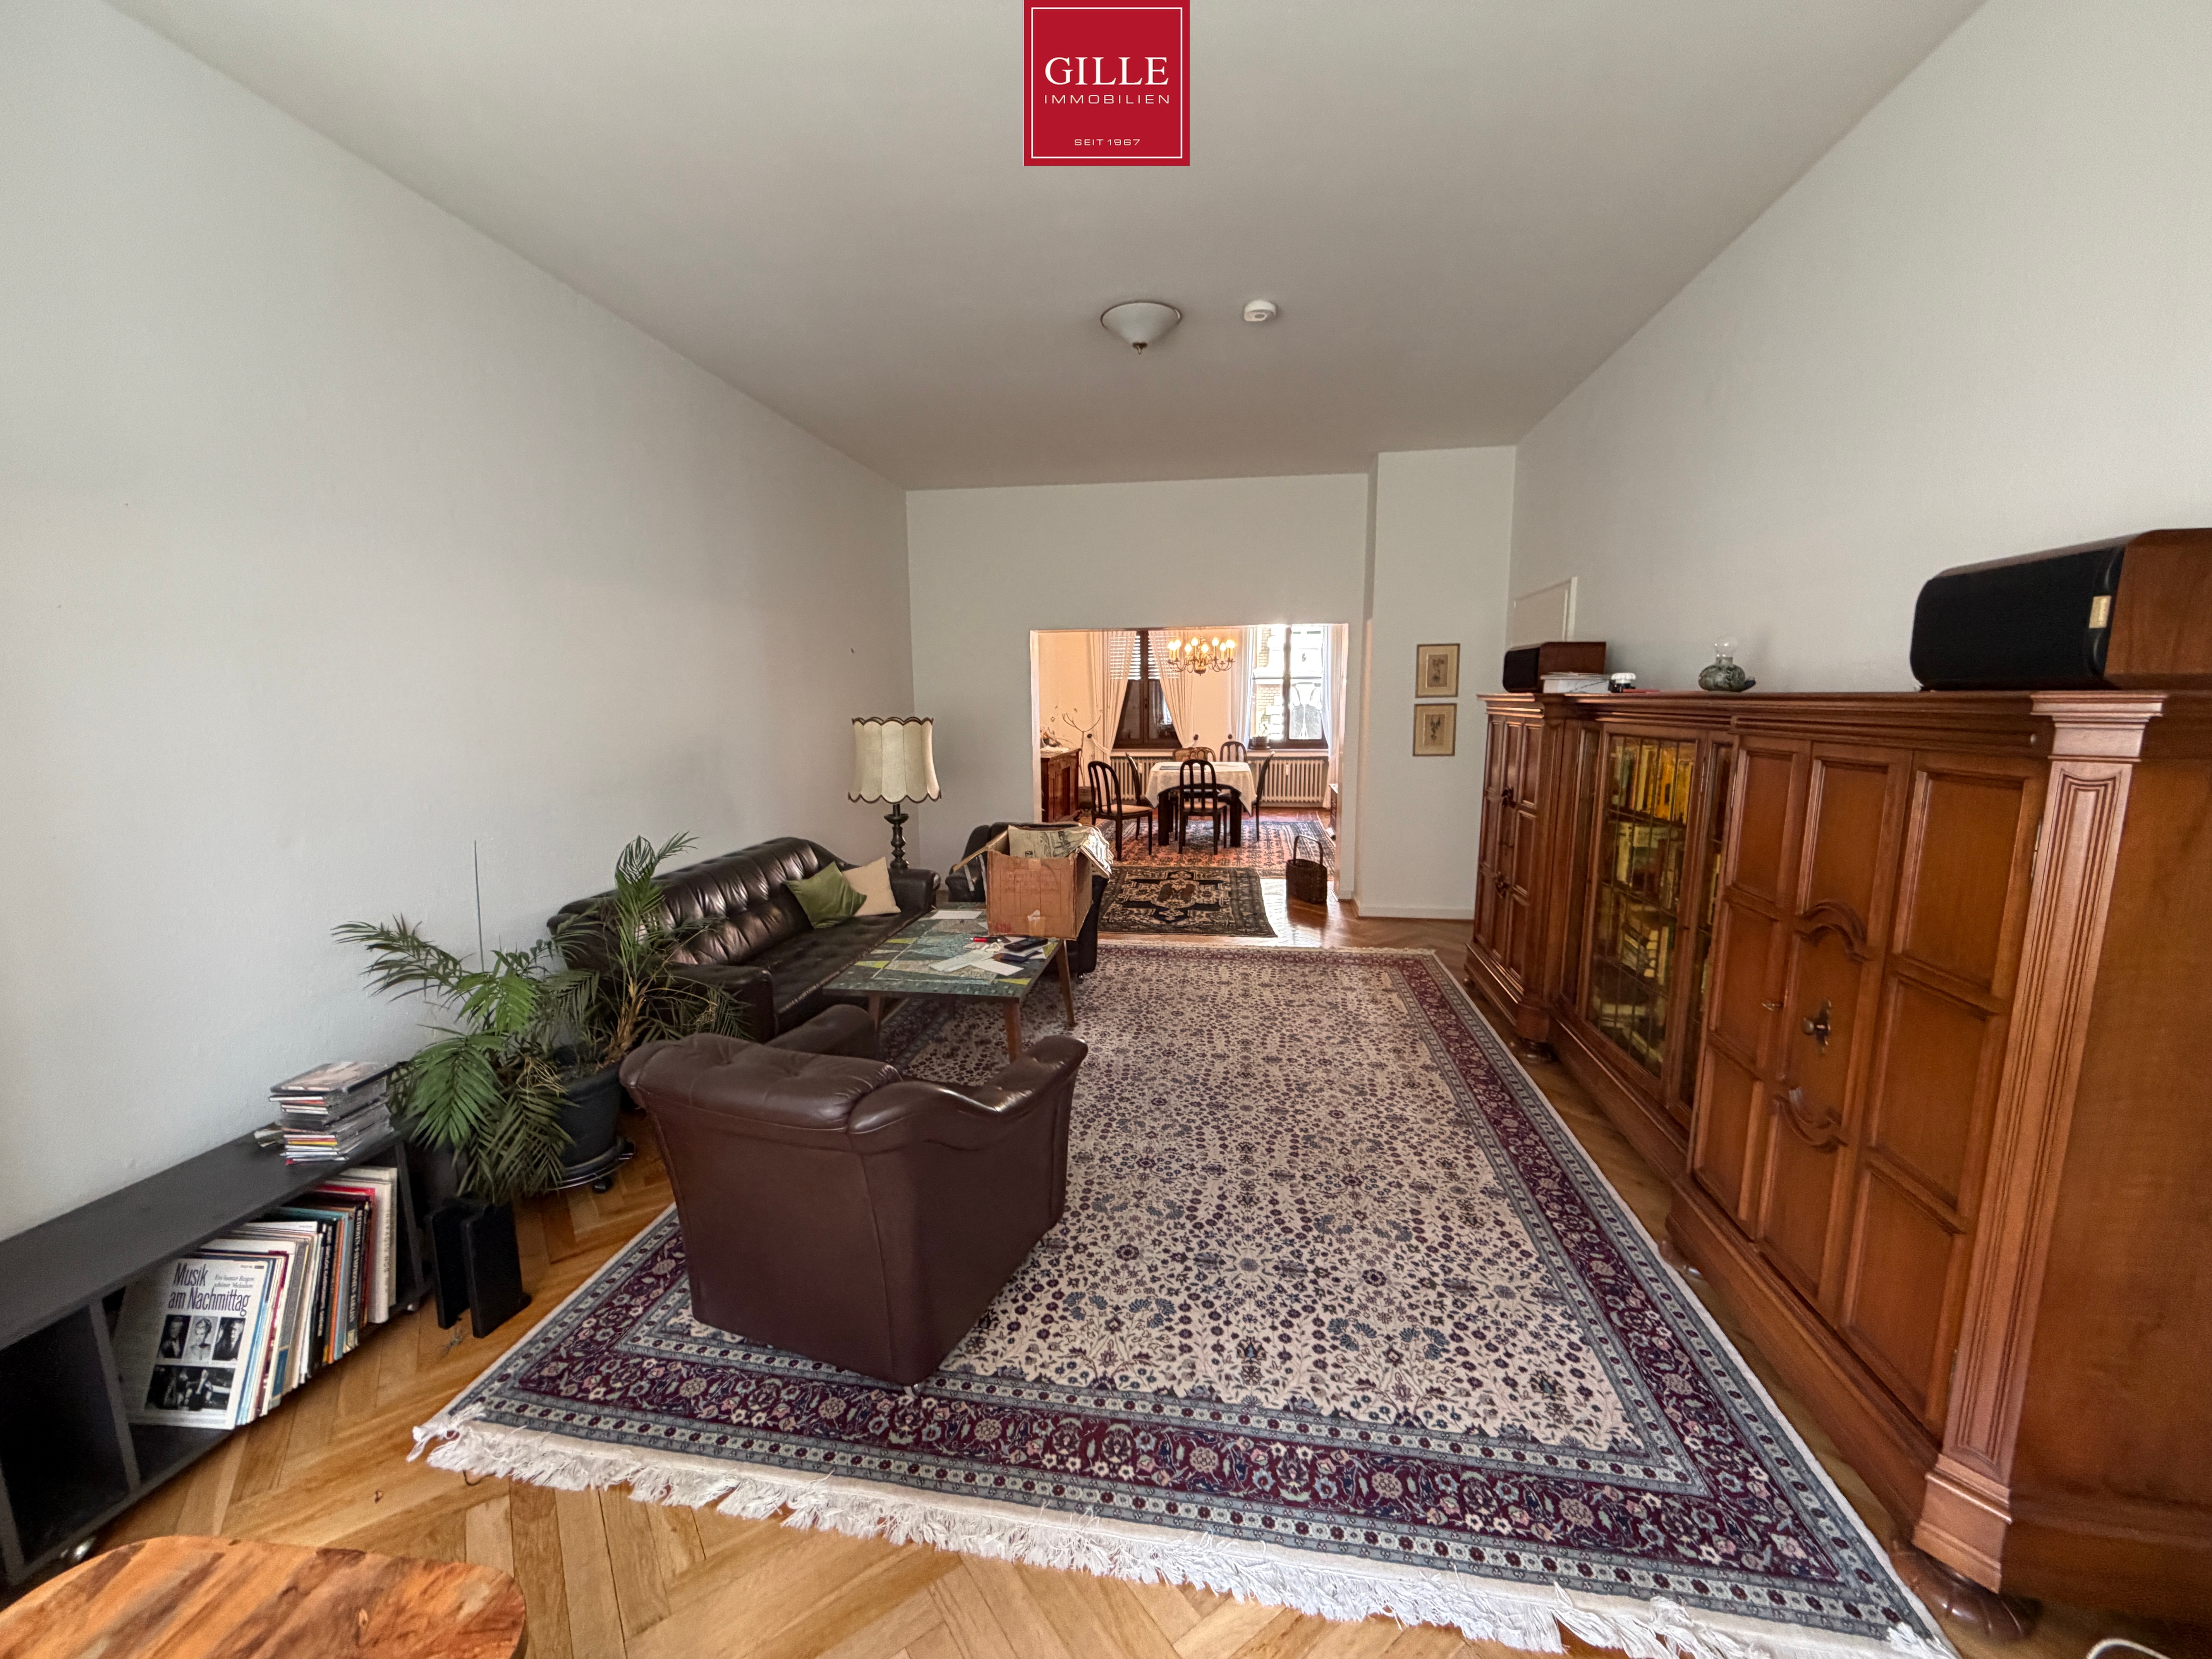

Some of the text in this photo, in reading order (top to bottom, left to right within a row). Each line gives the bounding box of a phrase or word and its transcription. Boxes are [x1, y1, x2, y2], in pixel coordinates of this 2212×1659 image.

[173, 1263, 209, 1286] Musik
[168, 1285, 251, 1317] am Nachmittag
